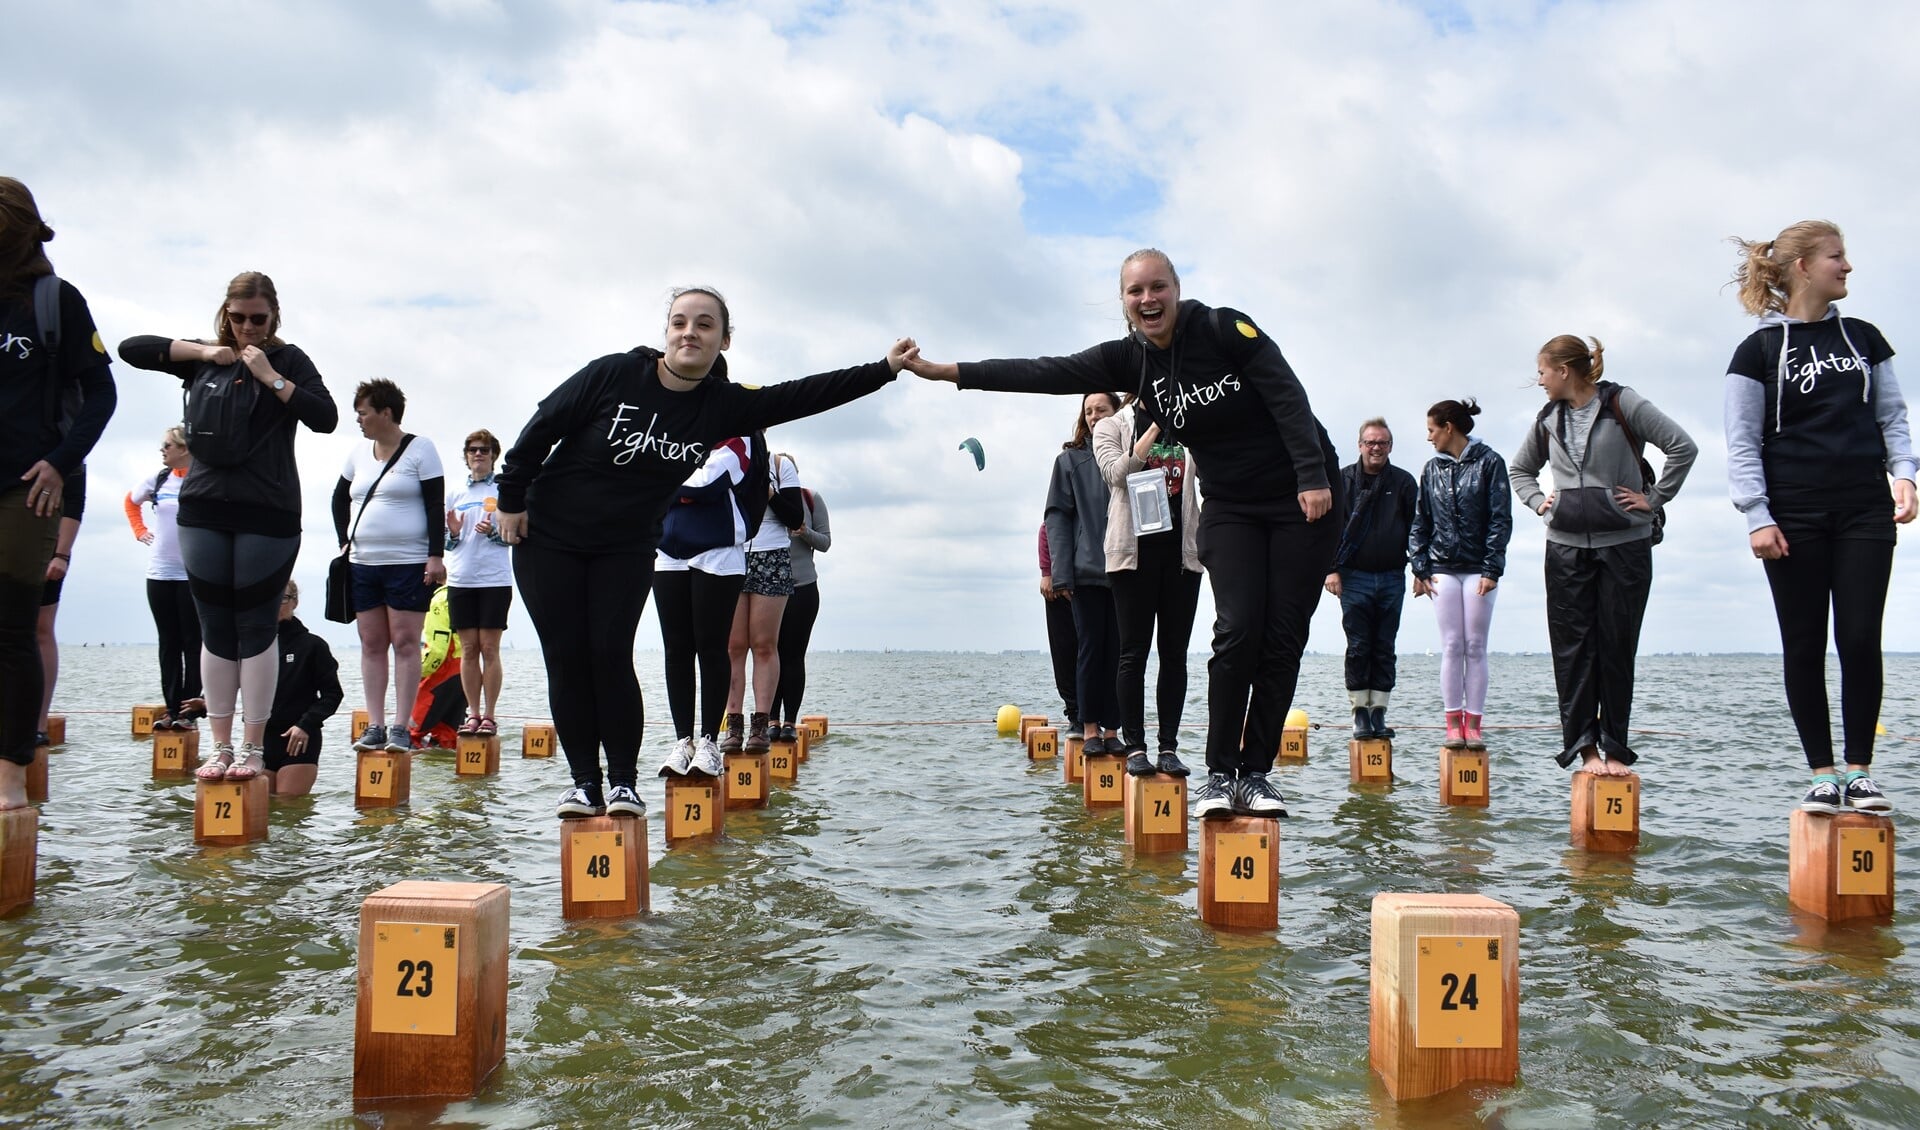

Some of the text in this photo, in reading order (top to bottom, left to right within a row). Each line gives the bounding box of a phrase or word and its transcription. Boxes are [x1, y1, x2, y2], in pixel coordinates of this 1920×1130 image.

[532, 738, 544, 747] 147
[1038, 743, 1051, 752] 149
[1286, 742, 1299, 751] 150
[163, 748, 177, 758] 121
[466, 752, 481, 763] 122
[772, 758, 787, 768] 123
[1367, 755, 1382, 765] 125
[370, 771, 383, 784] 97
[738, 772, 751, 785] 98
[1100, 775, 1113, 788] 99
[1459, 770, 1477, 783] 100
[215, 802, 231, 818] 72
[685, 804, 700, 821] 73
[1155, 800, 1170, 817] 74
[1607, 798, 1622, 814] 75
[587, 855, 609, 878] 48
[1853, 850, 1873, 872] 50
[1231, 857, 1253, 879] 49
[396, 959, 434, 998] 23
[1440, 972, 1479, 1011] 24
